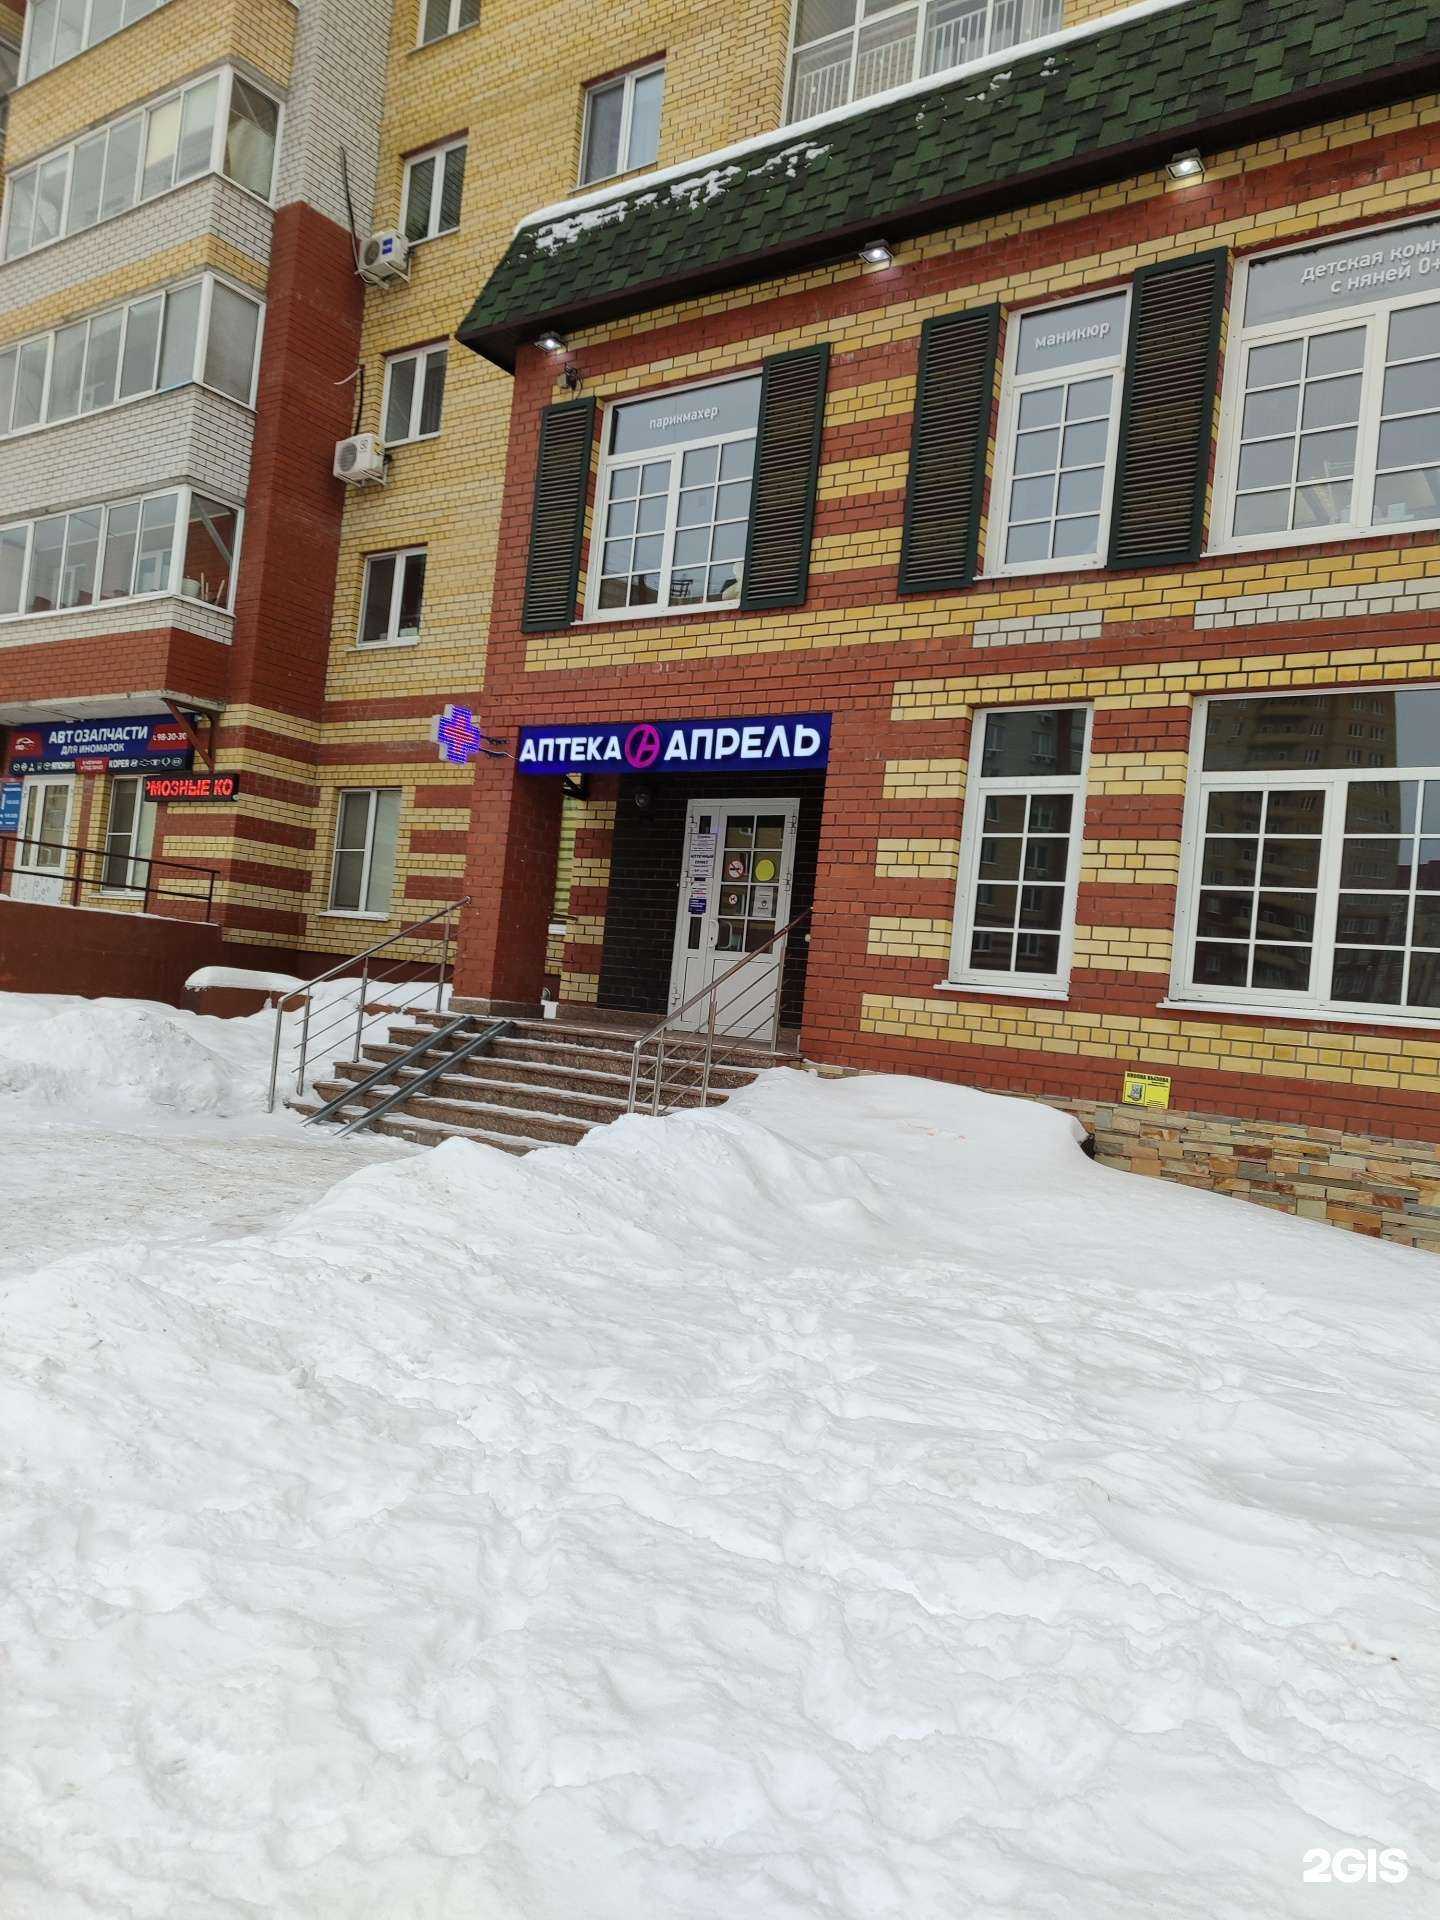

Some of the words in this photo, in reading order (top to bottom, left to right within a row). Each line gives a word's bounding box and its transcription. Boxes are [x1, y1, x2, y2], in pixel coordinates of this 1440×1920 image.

[1301, 251, 1384, 285] детская
[1331, 281, 1342, 292] с
[1348, 260, 1411, 290] няней
[1035, 322, 1109, 349] маникюр
[649, 406, 719, 429] парикмахер
[48, 726, 149, 744] АВТОЗАПЧАСТИ
[519, 736, 622, 762] АПТЕКА
[664, 724, 821, 760] АПРЕЛЬ
[61, 744, 78, 756] ДЛЯ
[79, 743, 125, 754] ИНОМАРОК
[214, 778, 233, 796] КО
